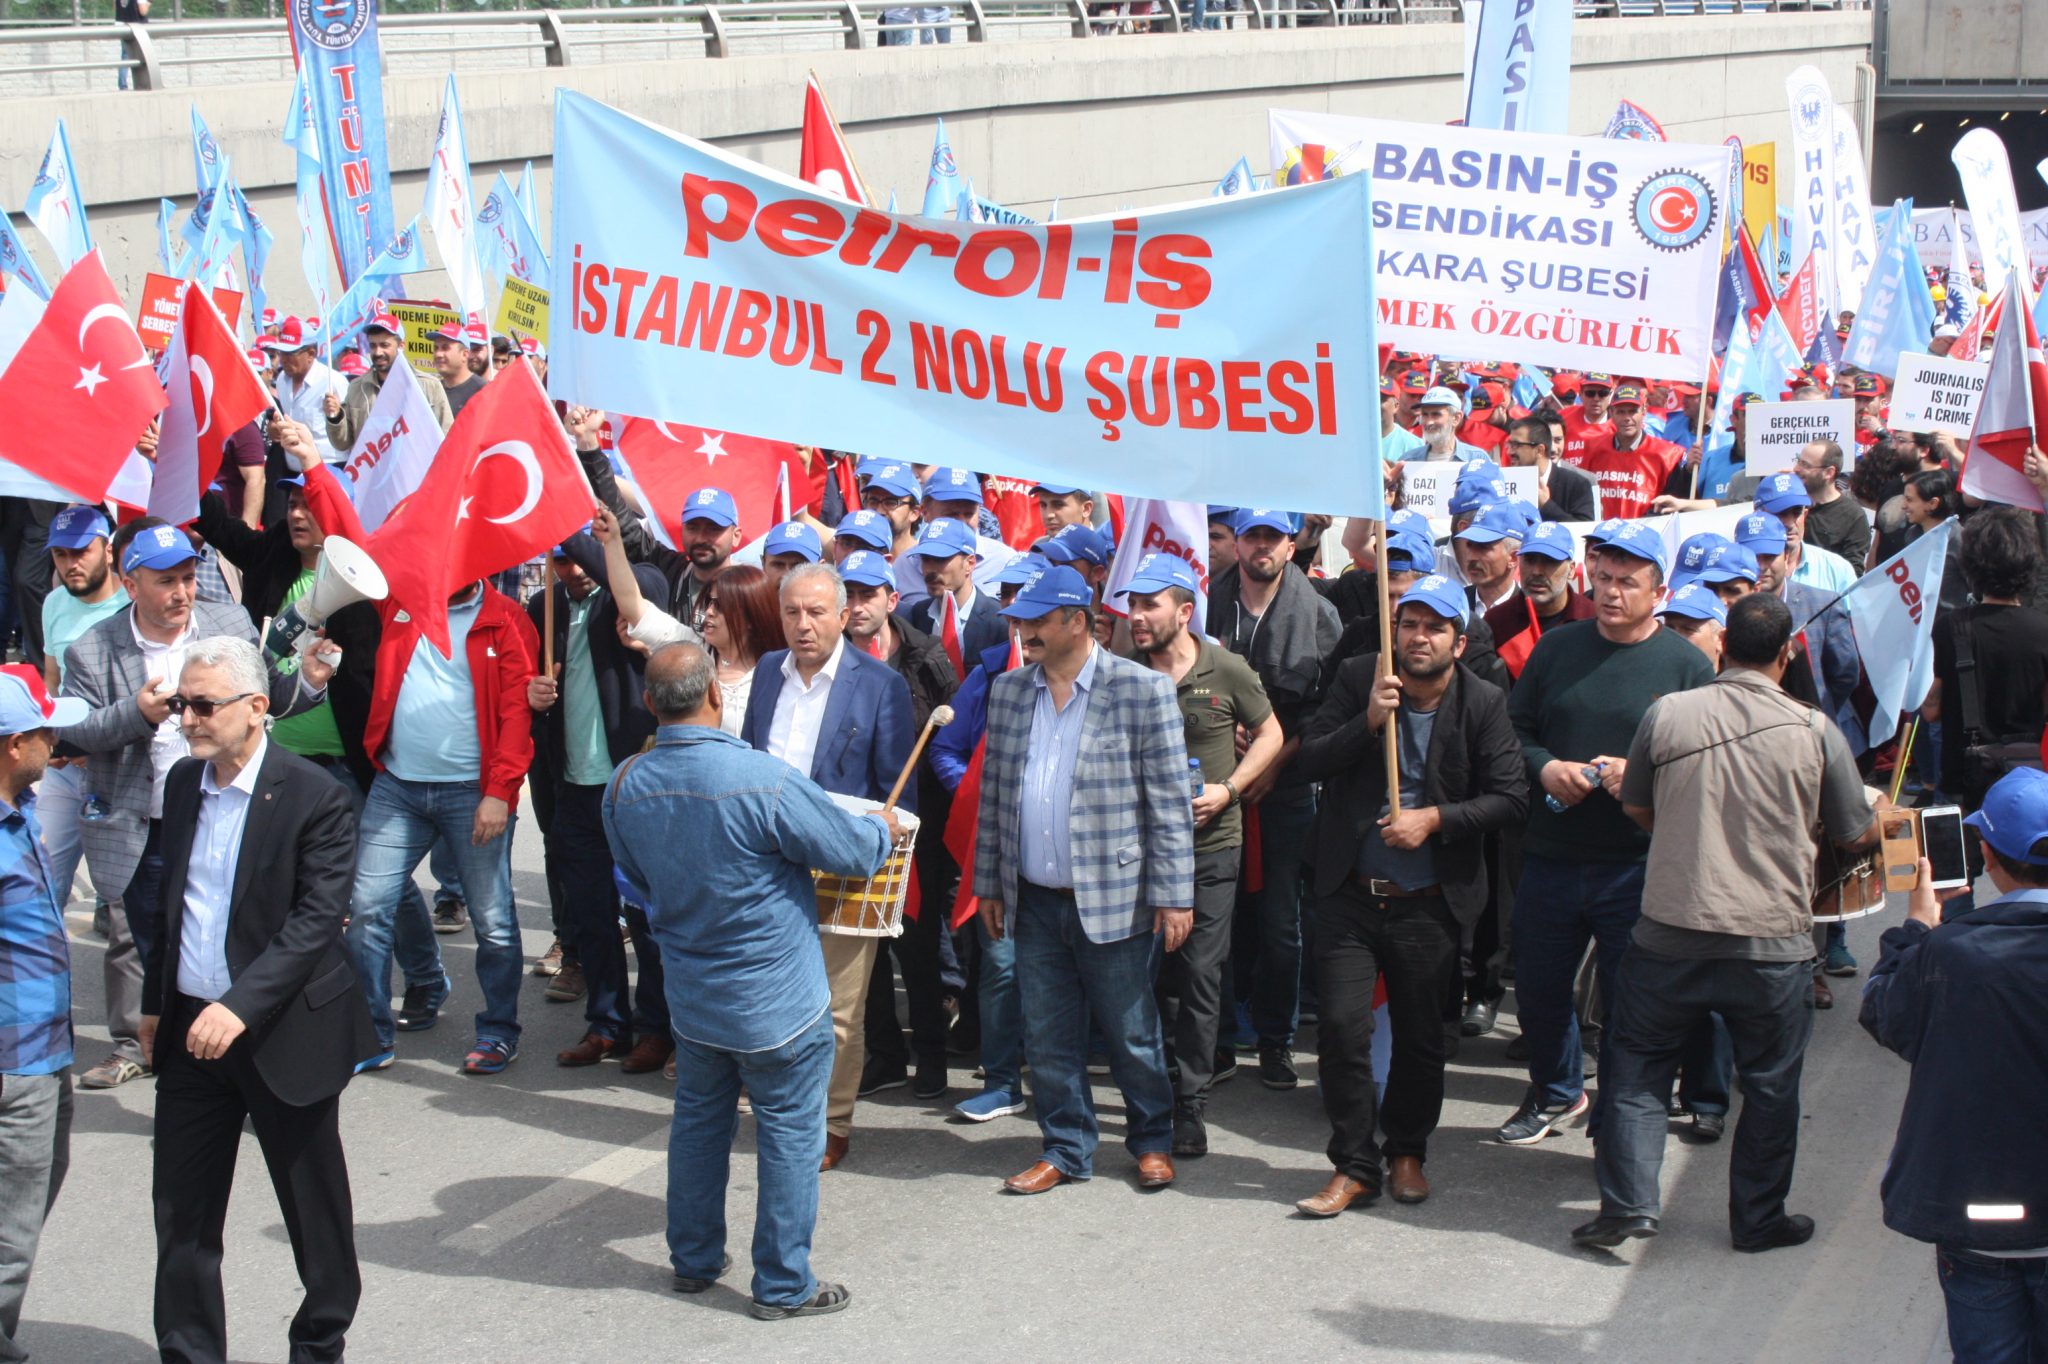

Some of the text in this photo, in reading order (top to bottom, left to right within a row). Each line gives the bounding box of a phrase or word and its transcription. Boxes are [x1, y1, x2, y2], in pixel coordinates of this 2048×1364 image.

[1372, 142, 1618, 209] BASIN-İŞ
[1372, 200, 1613, 248] SENDİKASI
[1655, 231, 1687, 244] 1952
[681, 171, 1213, 329] petrol-iş
[1376, 249, 1650, 301] KARA ŞUBESİ
[391, 309, 430, 323] KIDEME
[515, 299, 536, 314] ELLER
[1376, 297, 1684, 356] MEK ÖZGÜRLÜK
[572, 244, 1338, 442] İSTANBUL 2 NOLU ŞUBESİ
[1914, 370, 1984, 392] JOURNALIS
[1931, 389, 1971, 408] IS NOT
[1770, 415, 1830, 430] GERÇEKLER
[1923, 406, 1973, 426] A CRIME
